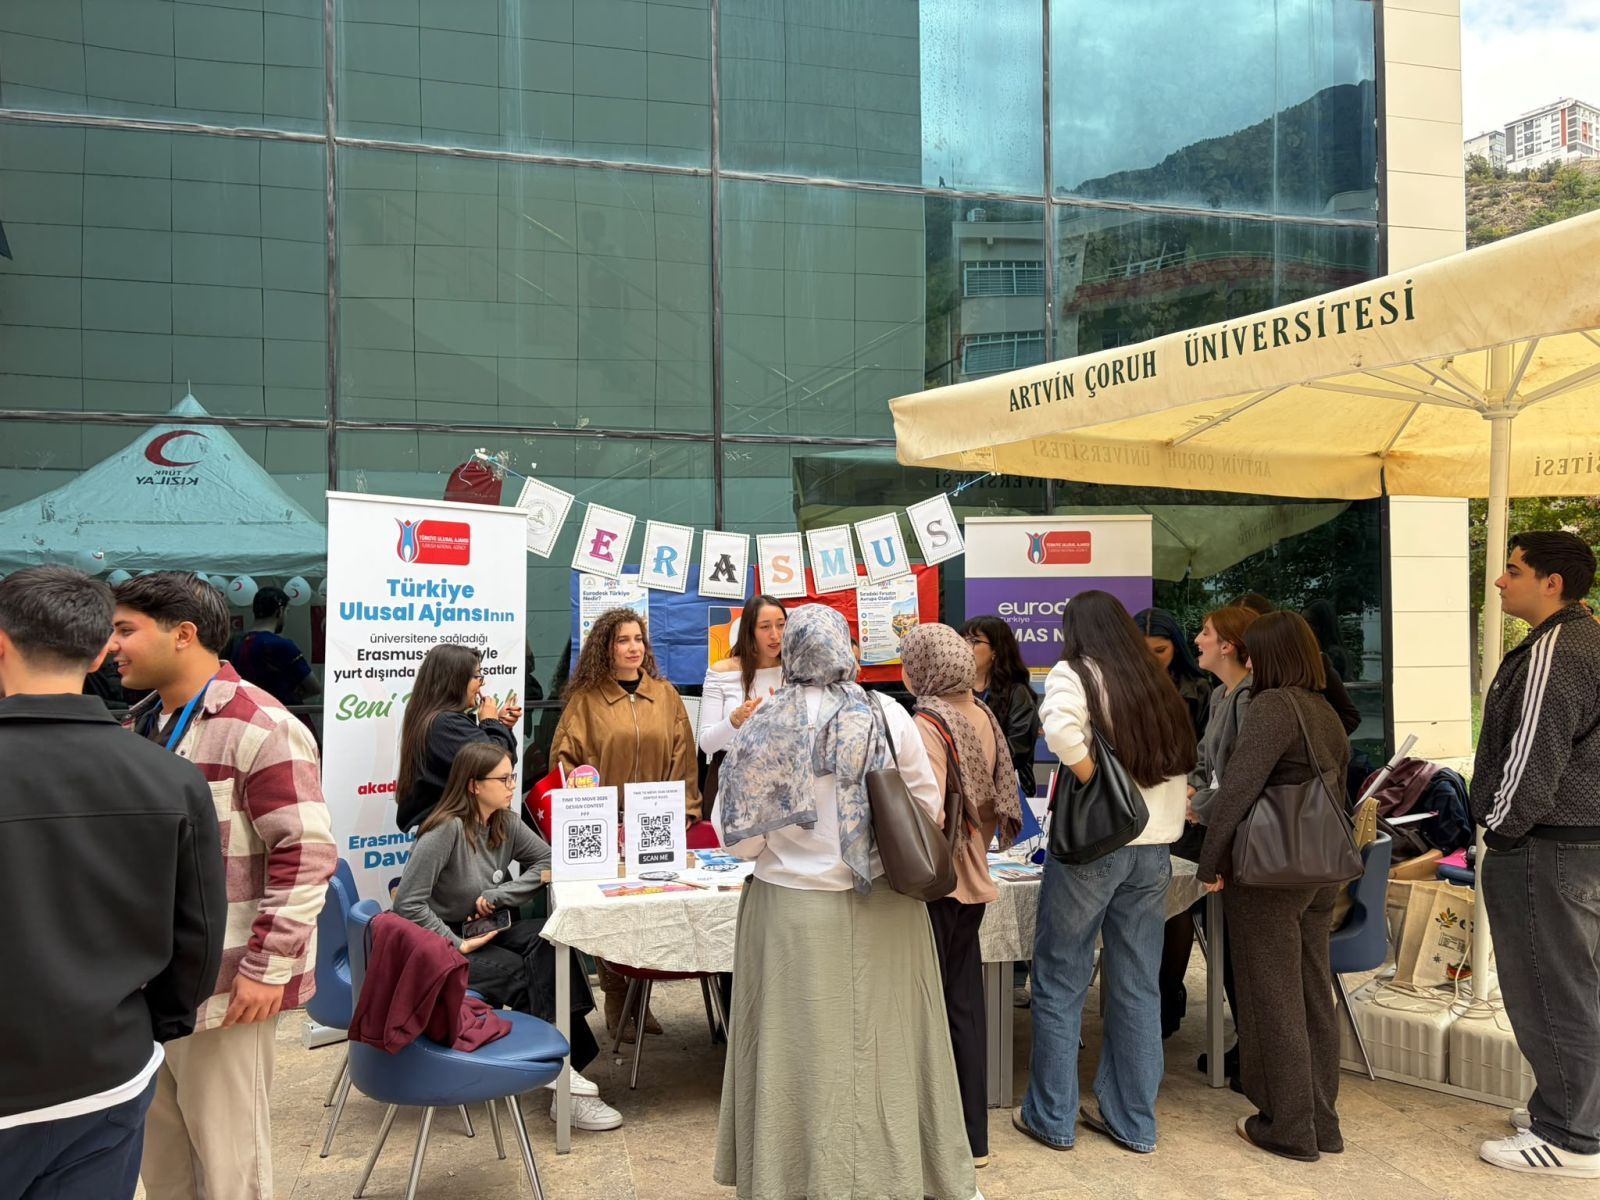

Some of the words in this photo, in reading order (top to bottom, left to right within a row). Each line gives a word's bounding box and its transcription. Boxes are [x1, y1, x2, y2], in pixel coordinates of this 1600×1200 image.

[1009, 371, 1075, 412] ARTVİN
[1085, 350, 1157, 398] ÇORUH
[1185, 279, 1415, 367] ÜNİVERSİTESİ
[386, 577, 475, 604] Türkiye
[339, 602, 414, 622] Ulusal
[418, 602, 515, 627] Ajansının
[998, 597, 1071, 616] eurod
[369, 632, 438, 644] üniversitene
[440, 632, 488, 646] sağladığı
[1014, 628, 1049, 642] MAS
[333, 670, 363, 683] yurt
[365, 668, 416, 681] dışında
[335, 692, 397, 721] Seni
[357, 780, 397, 795] akad
[349, 832, 417, 850] Erasmu
[364, 851, 411, 869] Dav
[642, 854, 657, 863] SCAN
